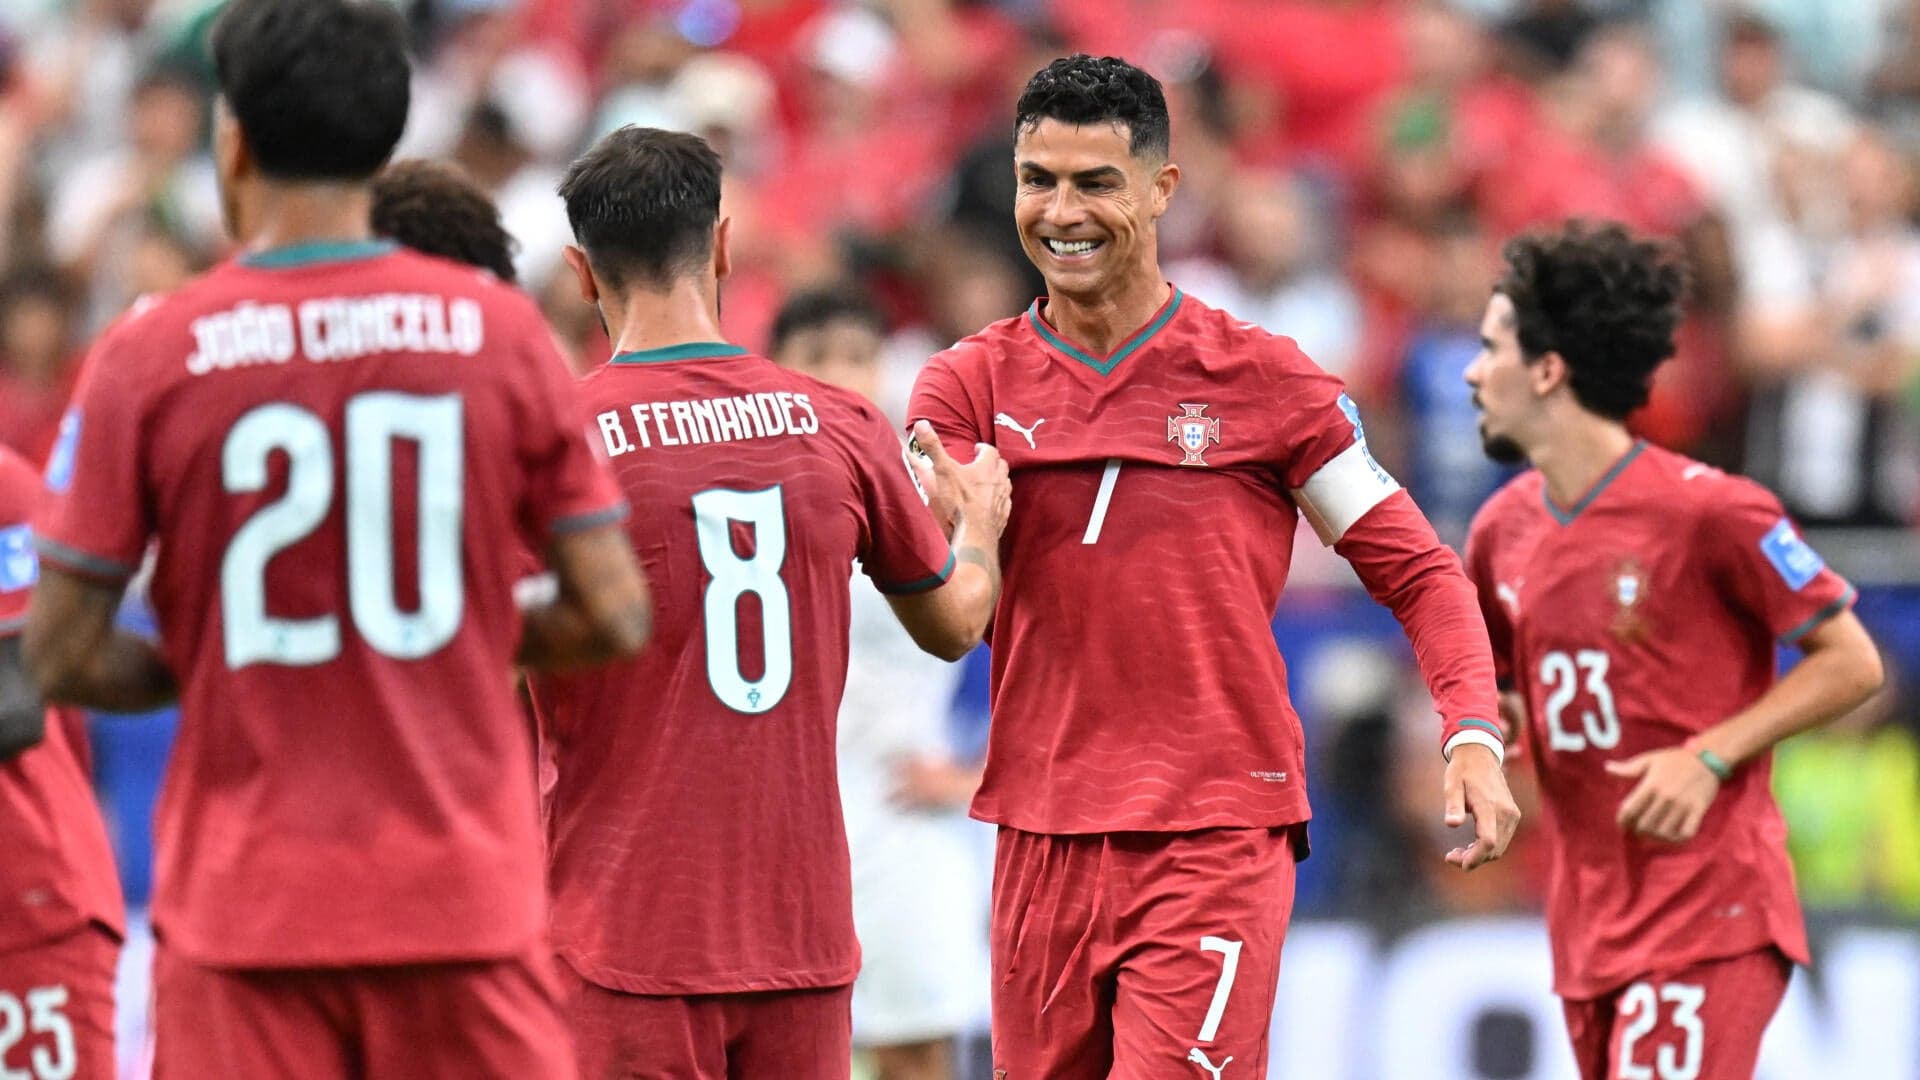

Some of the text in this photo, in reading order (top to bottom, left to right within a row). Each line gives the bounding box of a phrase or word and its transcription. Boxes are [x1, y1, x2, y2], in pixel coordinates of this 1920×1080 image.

[298, 292, 484, 362] CANCELO
[221, 391, 464, 670] 20
[691, 484, 793, 715] 8
[1539, 650, 1620, 751] 23
[0, 985, 78, 1080] 25
[1197, 935, 1243, 1042] 7
[1615, 983, 1706, 1080] 23
